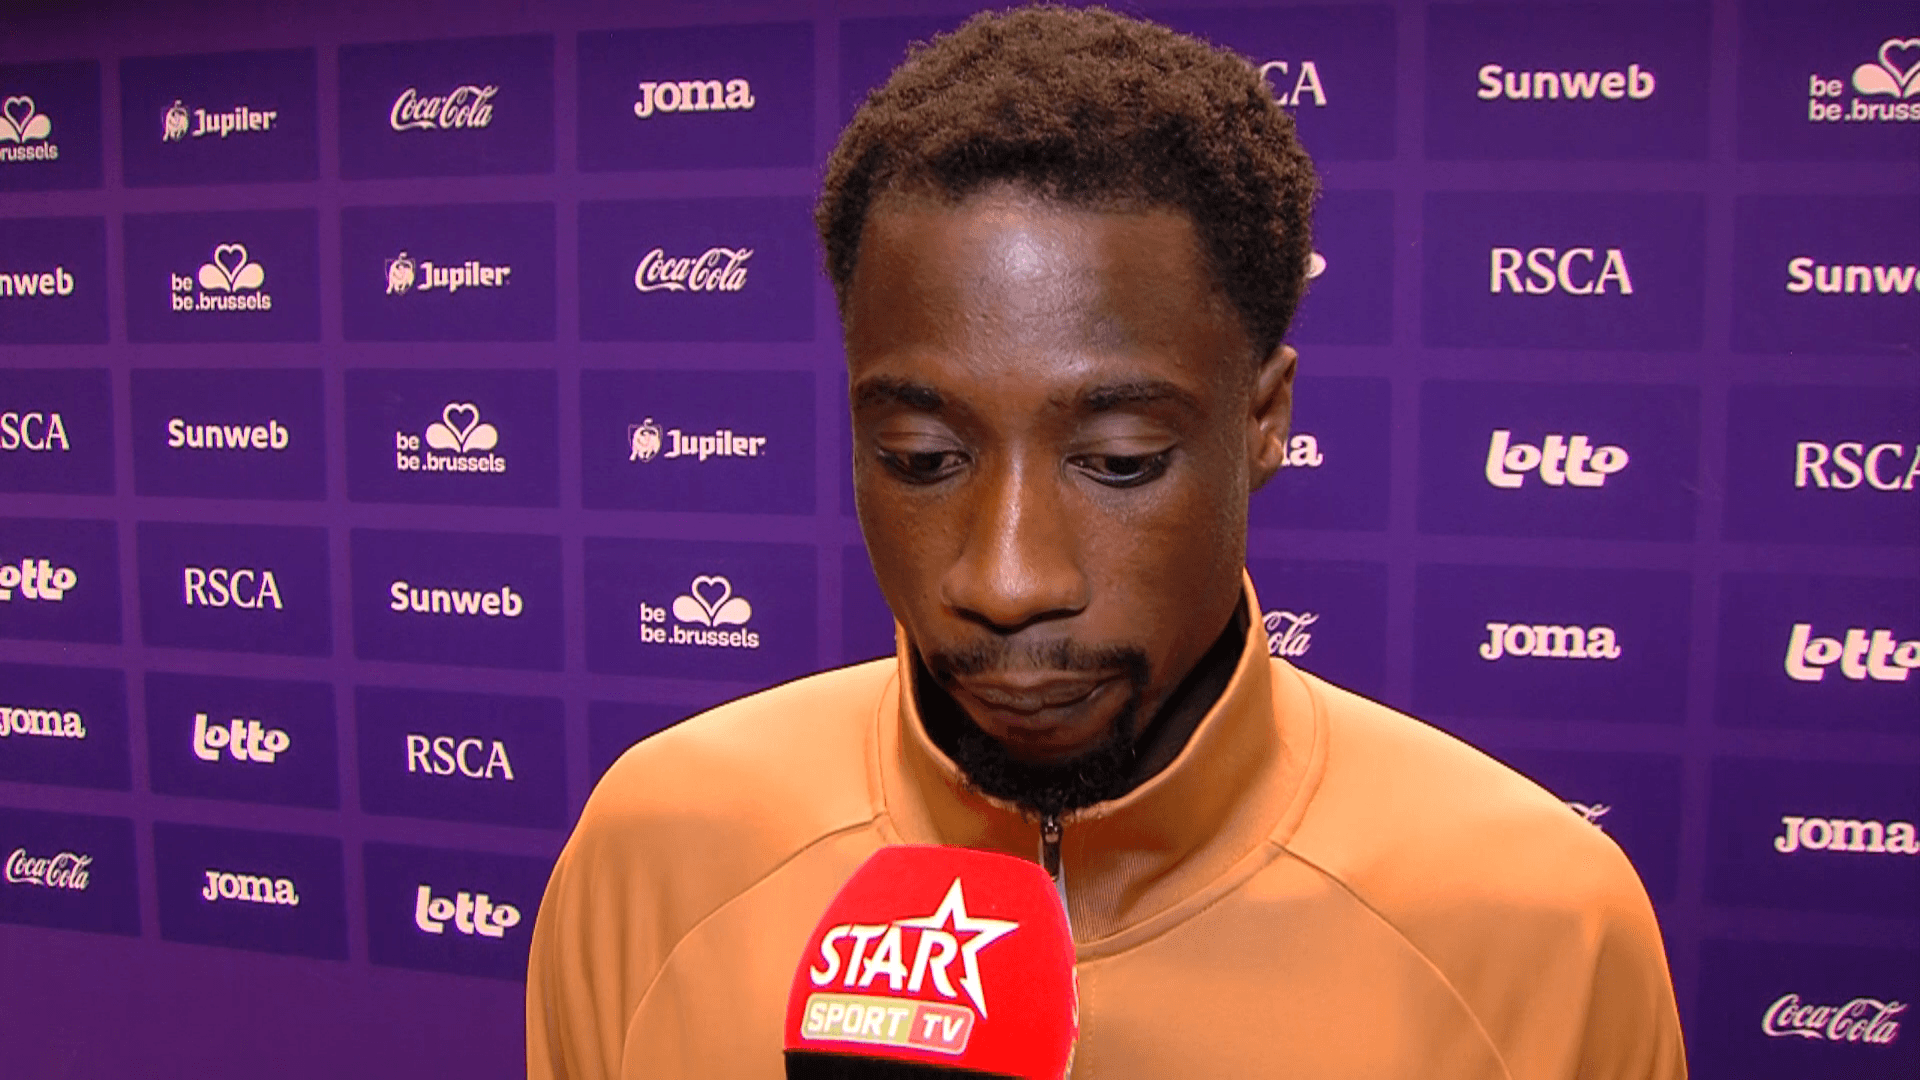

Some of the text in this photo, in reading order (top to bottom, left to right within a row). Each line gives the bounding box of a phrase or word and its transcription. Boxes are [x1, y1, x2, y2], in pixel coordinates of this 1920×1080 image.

[634, 79, 755, 117] Joma
[1260, 61, 1327, 106] CA
[1478, 64, 1654, 99] Sunweb
[1810, 75, 1842, 97] be
[193, 107, 276, 137] Jupiler
[172, 273, 192, 291] be
[418, 262, 510, 292] Jupiler
[1491, 248, 1632, 294] RSCA
[1787, 258, 1920, 293] Sunw
[0, 413, 69, 450] SCA
[169, 419, 288, 449] Sunweb
[397, 431, 418, 450] be
[664, 430, 766, 461] Jupiler
[185, 568, 282, 609] RSCA
[391, 582, 522, 616] Sunweb
[641, 602, 666, 622] be
[1480, 623, 1620, 660] Joma
[407, 735, 513, 780] RSCA
[1774, 817, 1920, 854] Joma
[203, 871, 299, 905] Joma
[810, 922, 957, 998] STAR
[807, 1001, 964, 1043] SPORT TV
